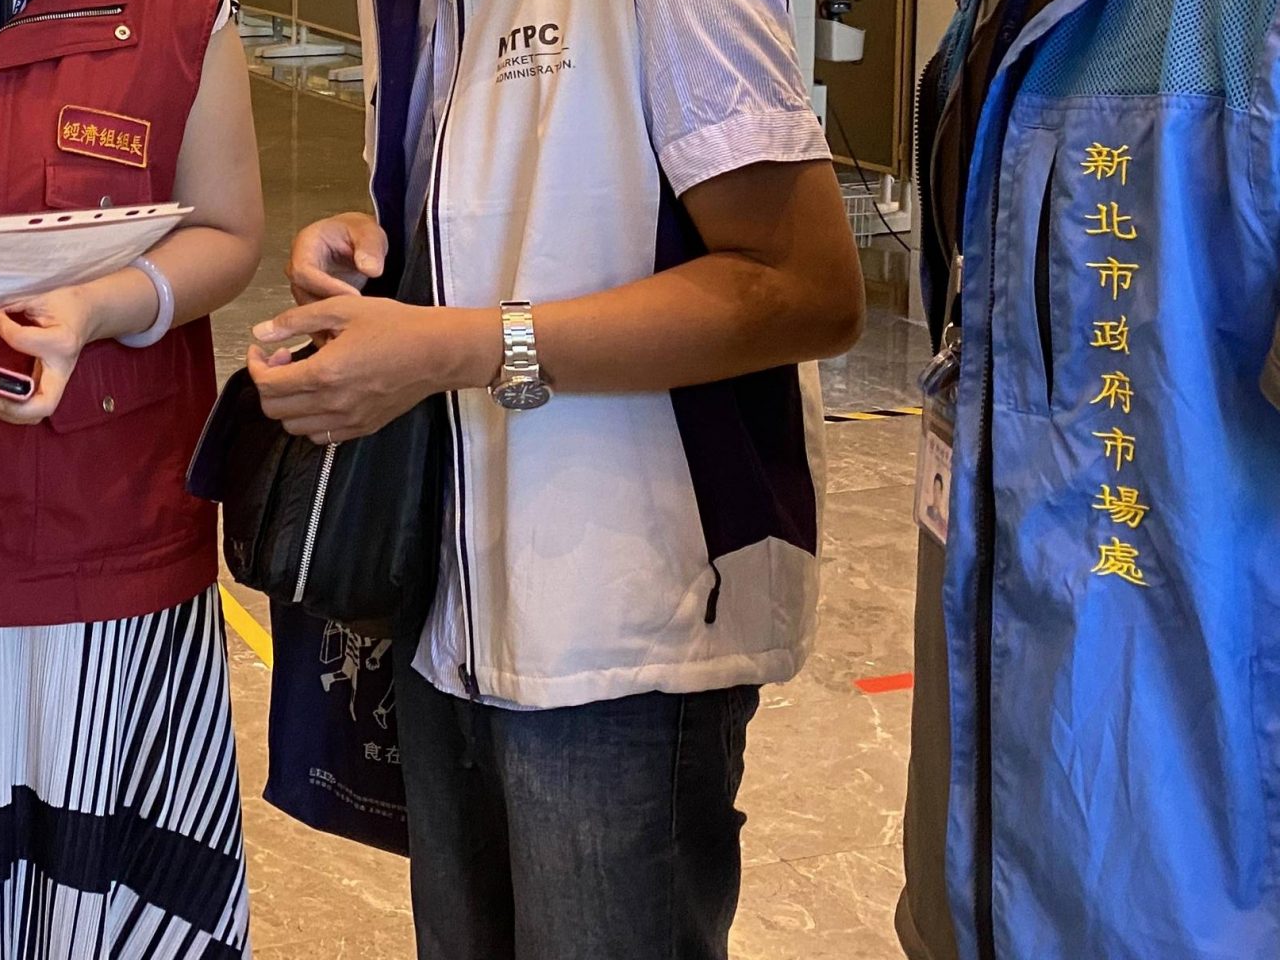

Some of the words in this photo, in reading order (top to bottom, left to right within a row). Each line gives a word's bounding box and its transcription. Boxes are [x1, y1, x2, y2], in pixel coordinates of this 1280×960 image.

[63, 121, 143, 157] 經濟組組長
[1080, 142, 1151, 588] 新北市政府市場處
